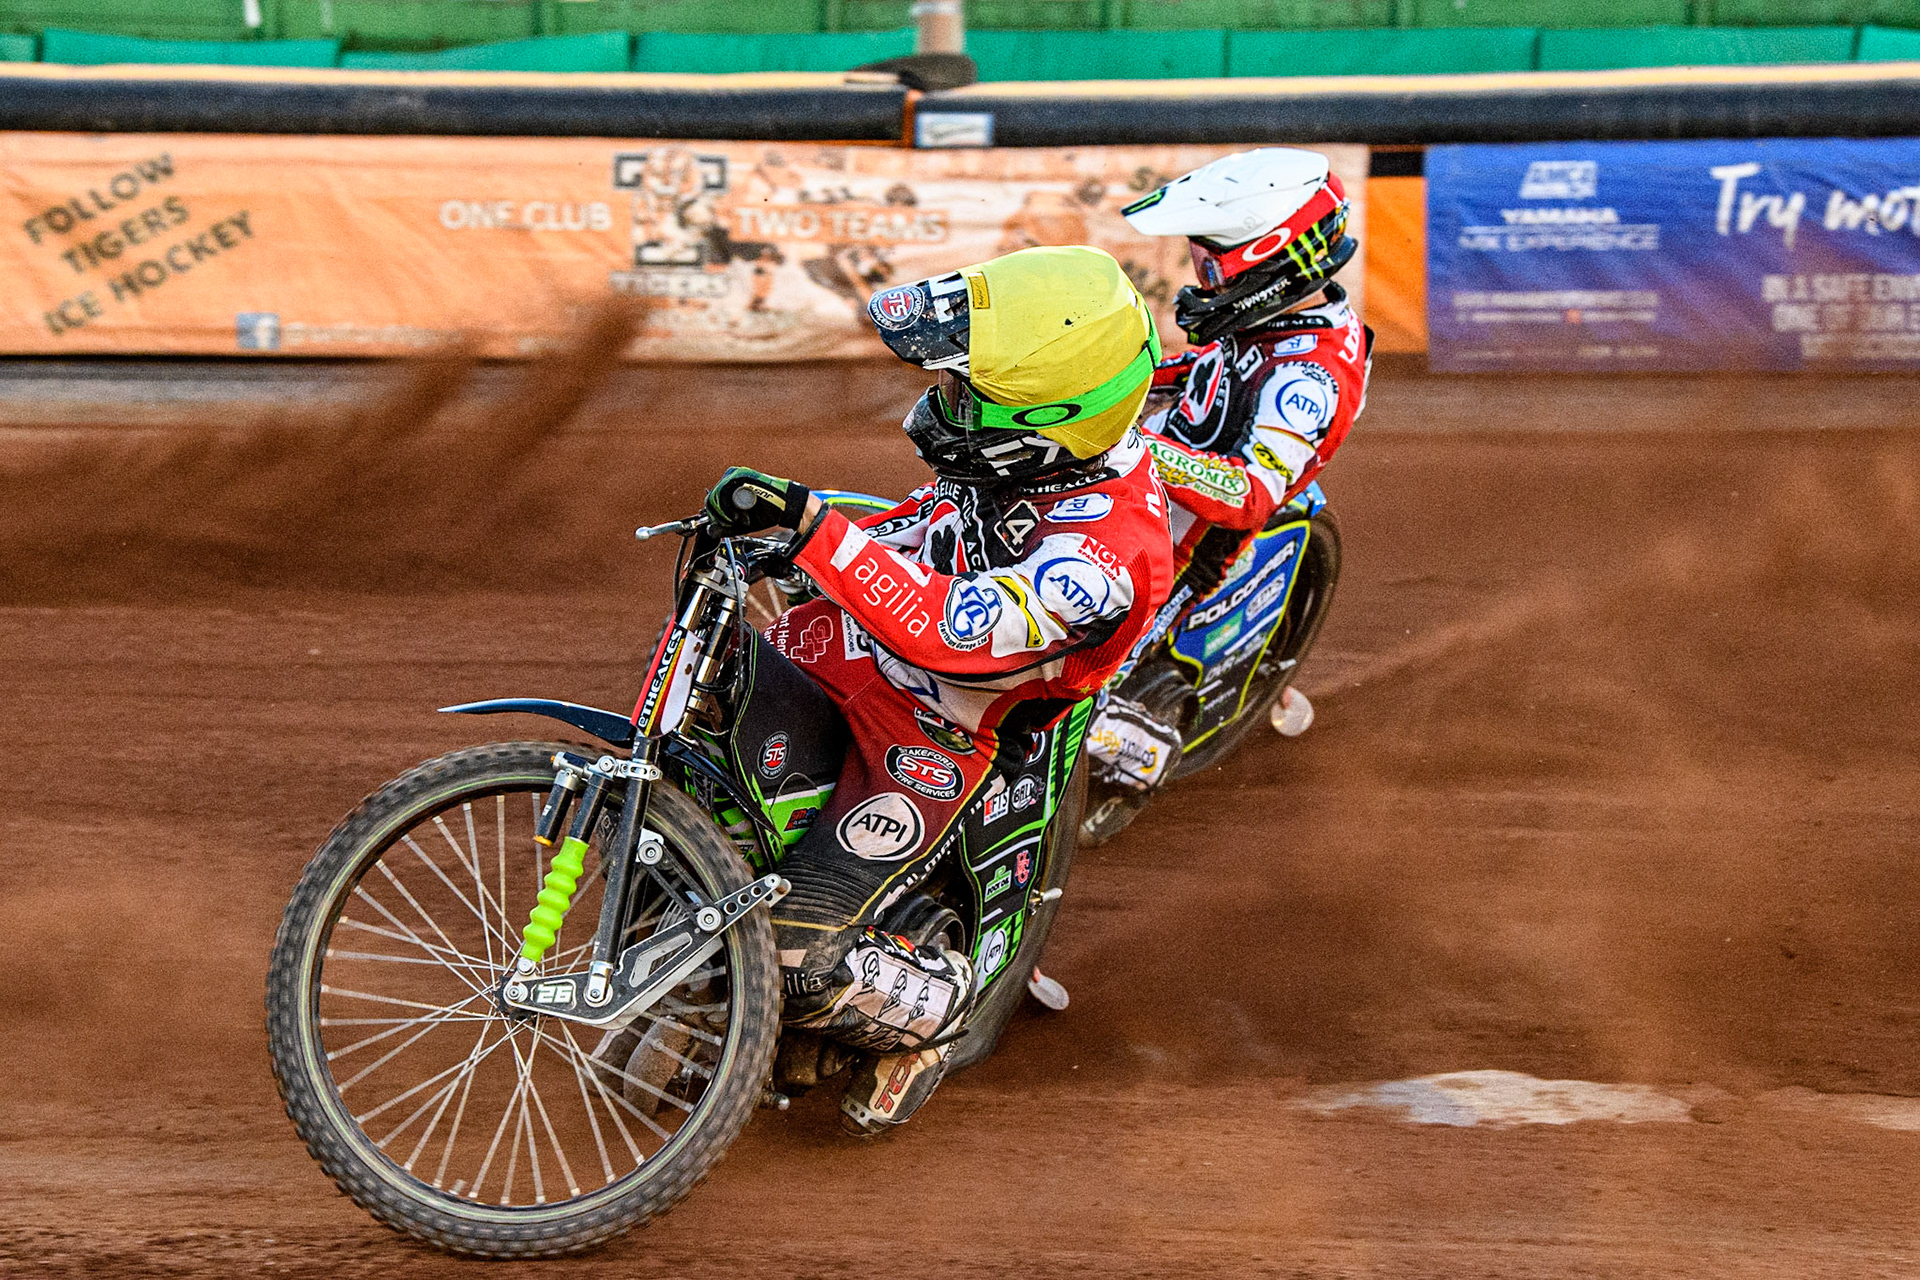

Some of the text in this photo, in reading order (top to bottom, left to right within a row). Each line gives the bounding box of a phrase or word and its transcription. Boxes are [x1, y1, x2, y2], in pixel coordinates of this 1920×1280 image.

[23, 152, 175, 246] FOLLOW
[439, 199, 613, 231] ONE CLUB
[1710, 162, 1805, 249] Try
[60, 195, 190, 274] TIGERS
[736, 206, 944, 241] TWO TEAMS
[43, 209, 254, 336] ICE HOCKEY
[1232, 278, 1291, 311] MONSTER
[1285, 392, 1322, 420] ATPI
[1149, 441, 1239, 492] AGROMIX
[934, 481, 962, 502] BELLE
[1005, 518, 1035, 546] 4
[1077, 548, 1118, 581] SPARK PLUGS
[1081, 535, 1122, 577] NGK
[855, 556, 931, 639] agilia
[1049, 573, 1097, 613] ATPI
[764, 746, 787, 763] STS
[899, 756, 952, 784] STS
[893, 770, 957, 798] TYRE SERVICES
[851, 812, 908, 843] ATPI
[537, 983, 570, 1004] 26
